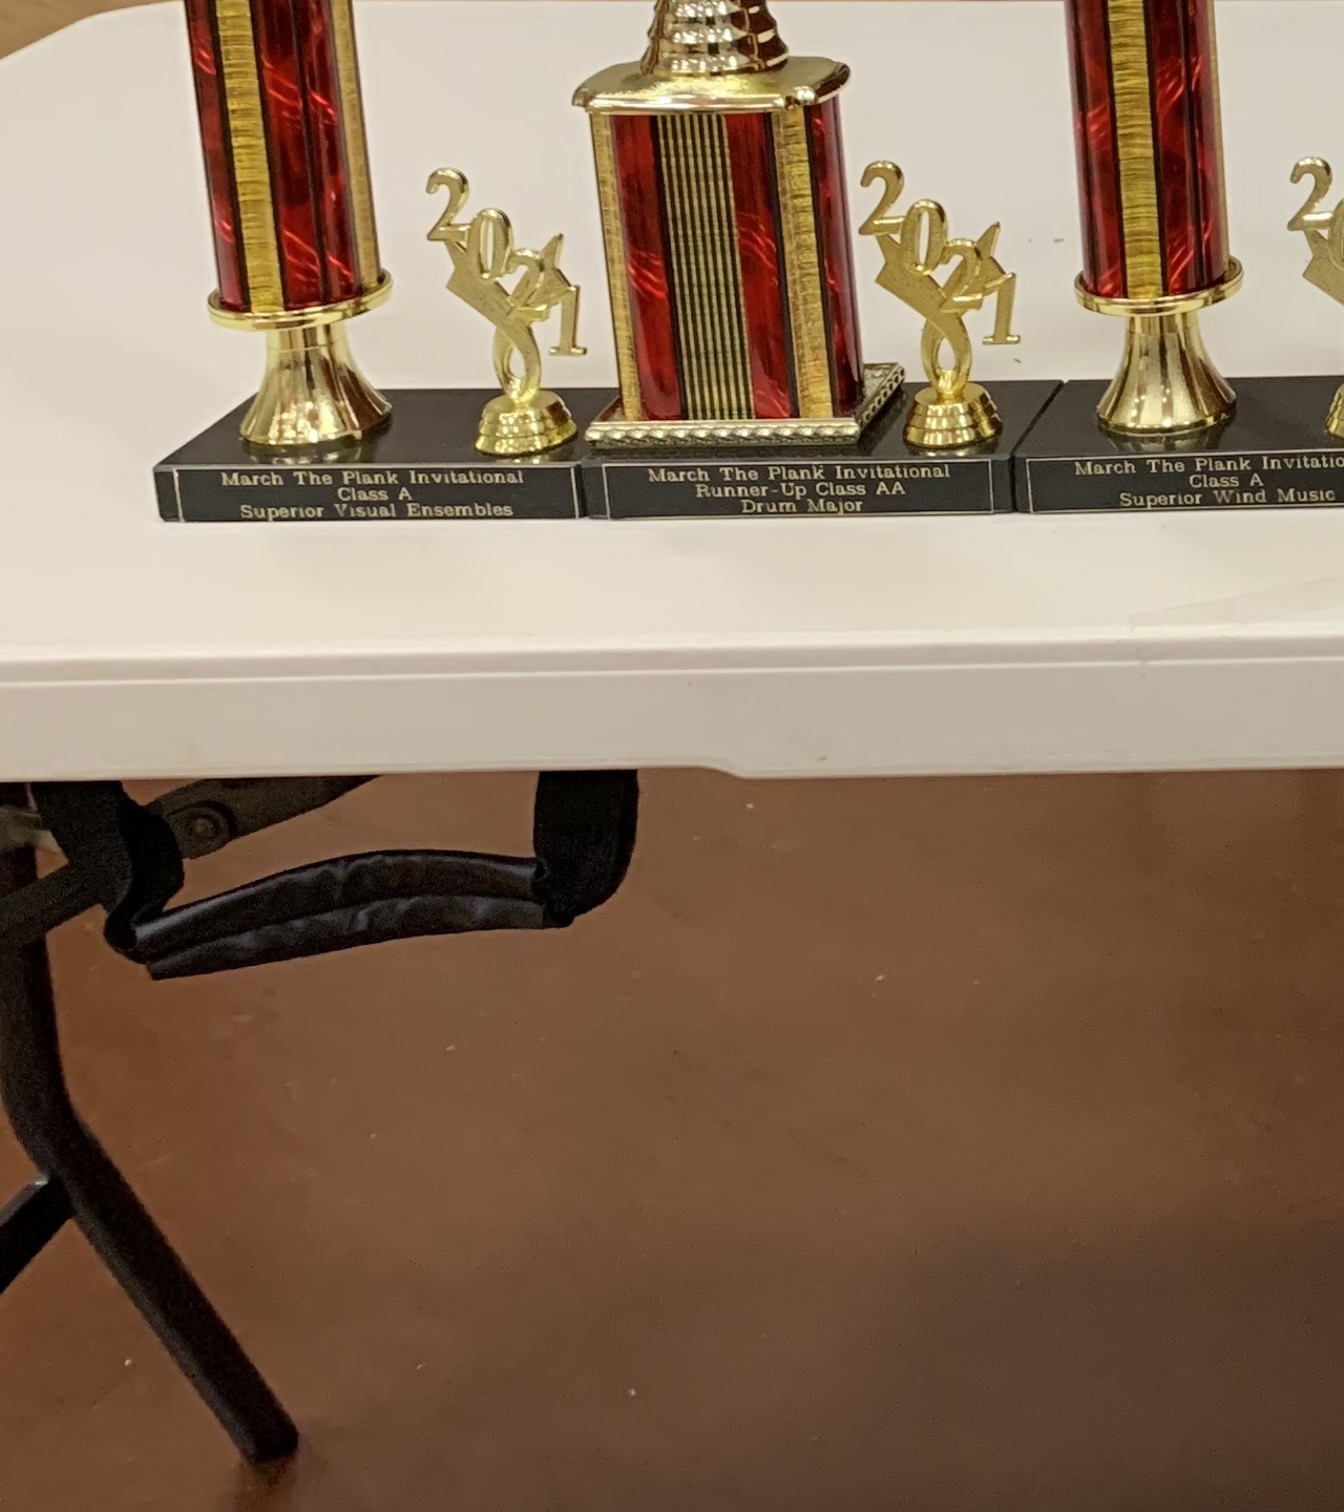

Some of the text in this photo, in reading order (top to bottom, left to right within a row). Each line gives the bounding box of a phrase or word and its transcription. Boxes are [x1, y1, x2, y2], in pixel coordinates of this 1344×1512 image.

[859, 160, 1020, 344] 2021
[426, 167, 587, 356] 2021
[648, 465, 950, 482] March The Plank Invitational
[1075, 460, 1136, 475] March
[1147, 459, 1185, 473] The
[1195, 458, 1251, 471] Plank
[222, 470, 524, 486] March The Plank Invitational
[1189, 474, 1264, 488] Class A
[338, 488, 413, 501] Class A
[696, 482, 906, 498] Runner-Up Class AA
[1120, 488, 1336, 509] Superior Wind Music
[240, 503, 513, 521] Superior Visual Ensembles
[741, 498, 863, 515] Drum Major
